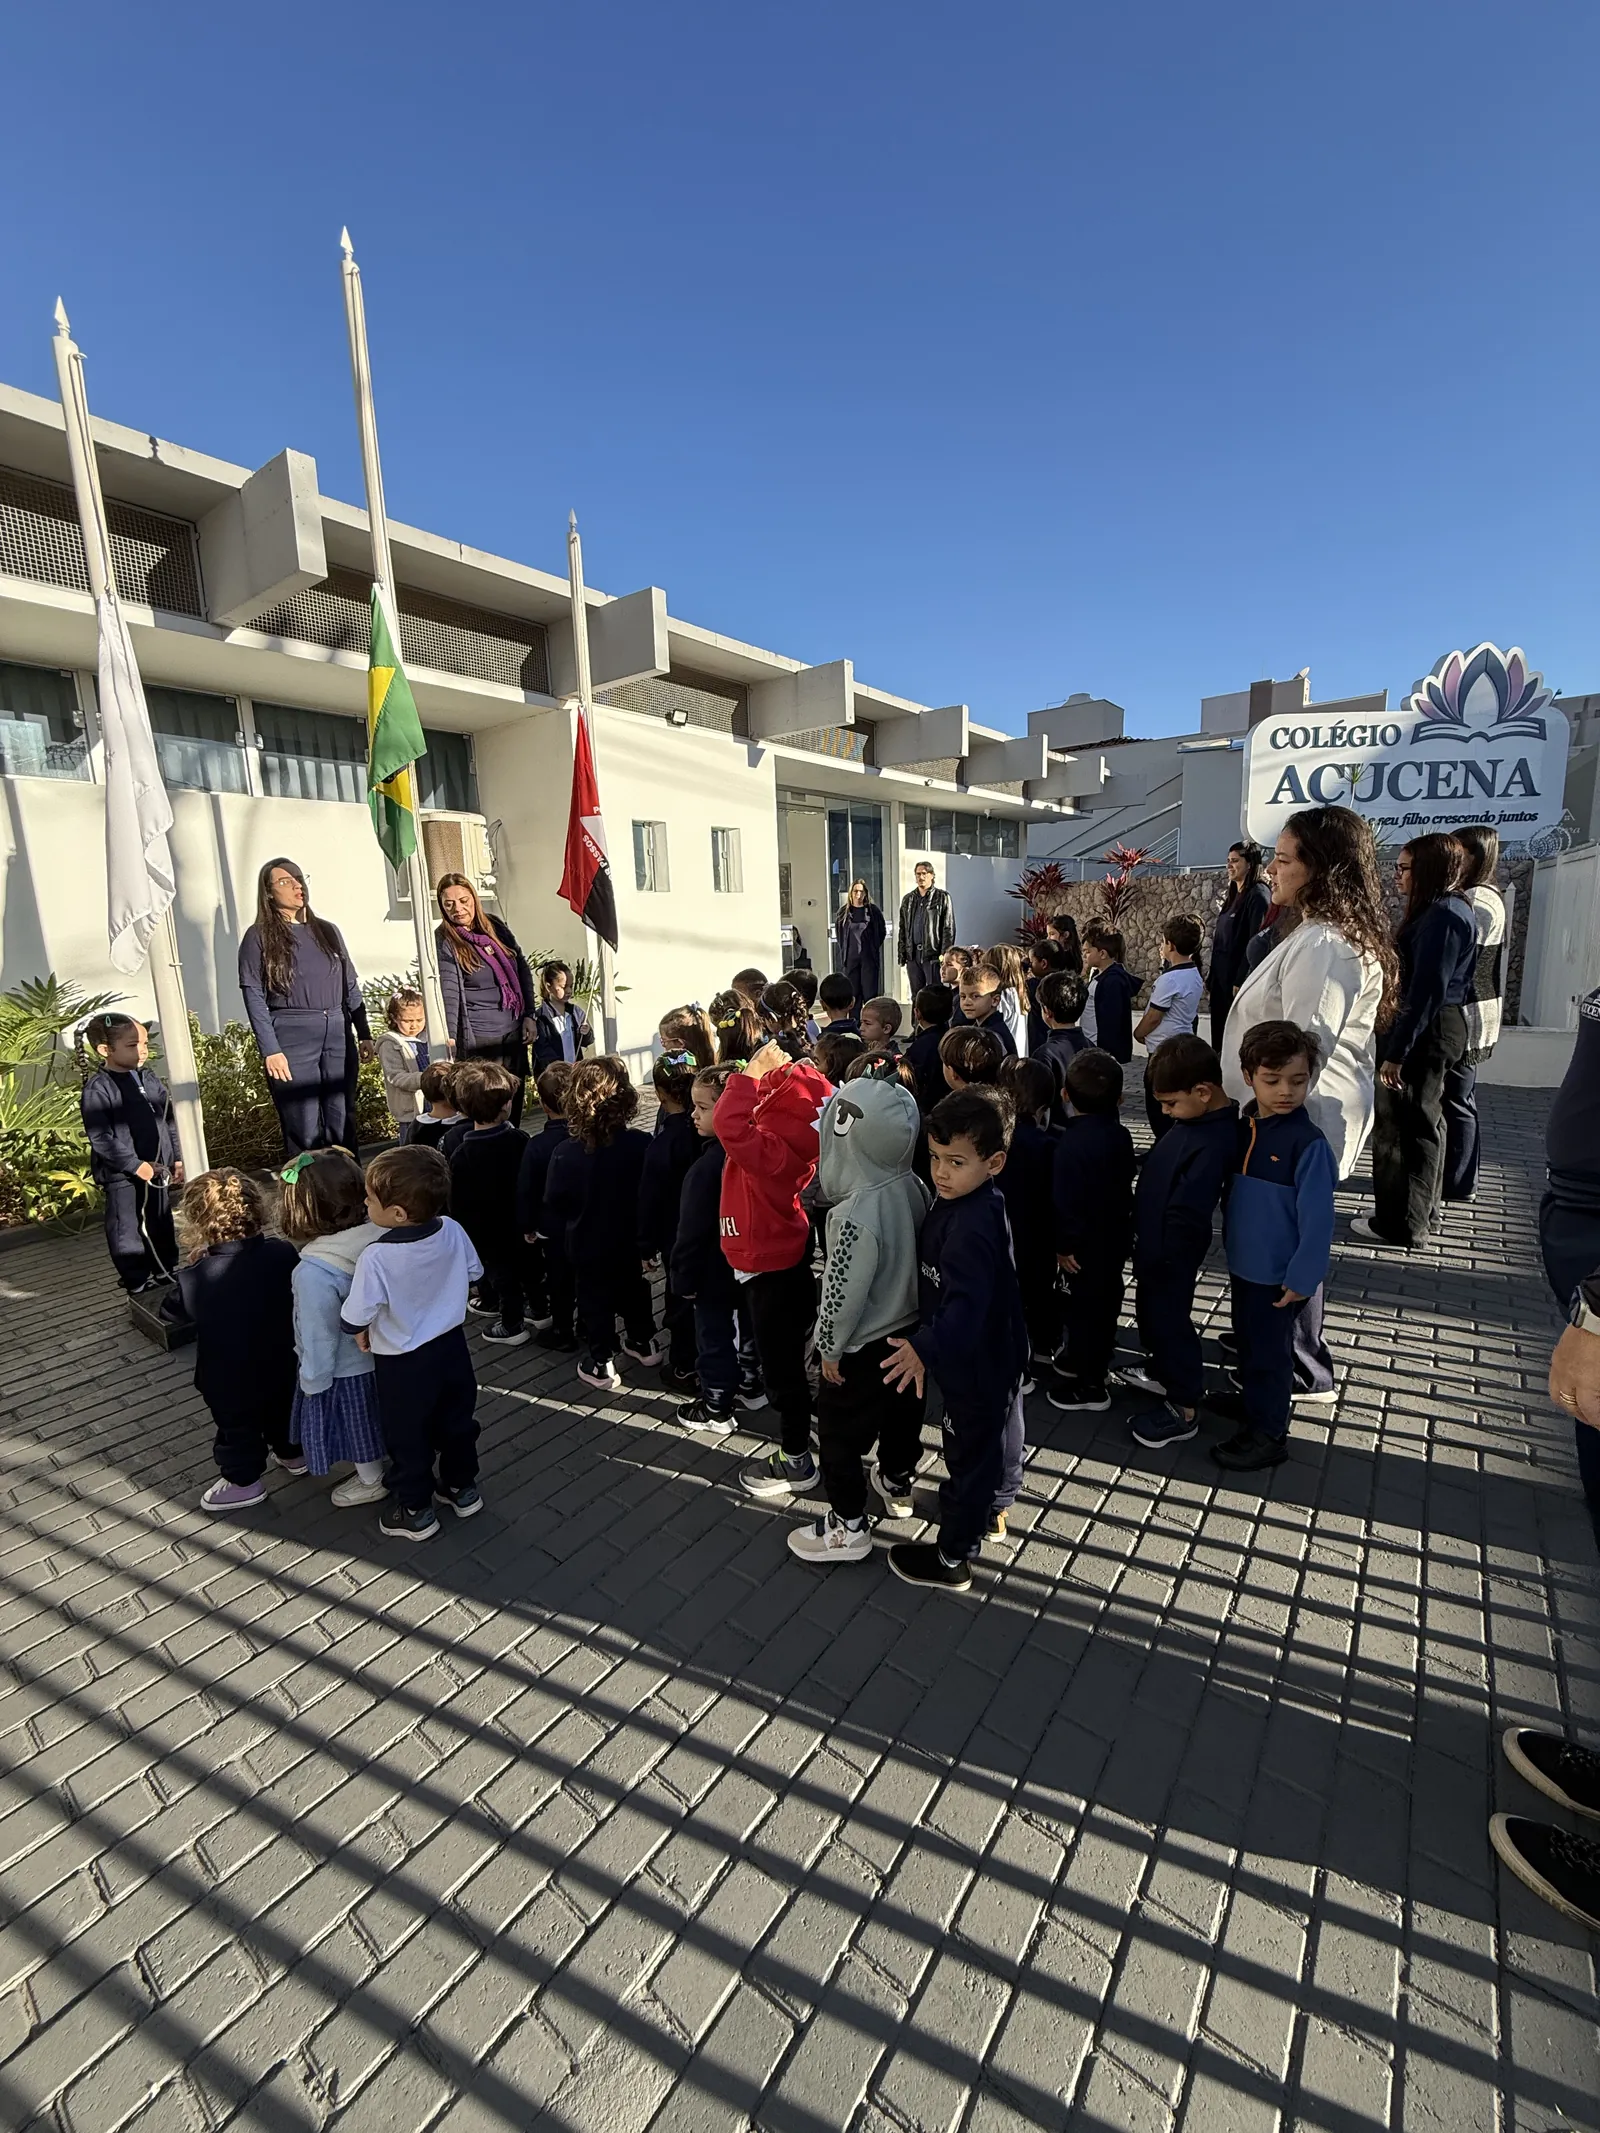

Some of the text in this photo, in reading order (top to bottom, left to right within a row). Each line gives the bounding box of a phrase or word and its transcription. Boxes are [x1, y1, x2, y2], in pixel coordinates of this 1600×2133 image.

[1269, 719, 1402, 749] COLÉGIO
[1265, 757, 1541, 807] AÇUCENA
[1377, 816, 1399, 826] seu
[1399, 812, 1430, 828] filho
[1432, 810, 1496, 825] crescendo
[1495, 810, 1539, 827] juntos
[582, 834, 608, 868] PASSOS
[719, 1216, 740, 1237] VEL
